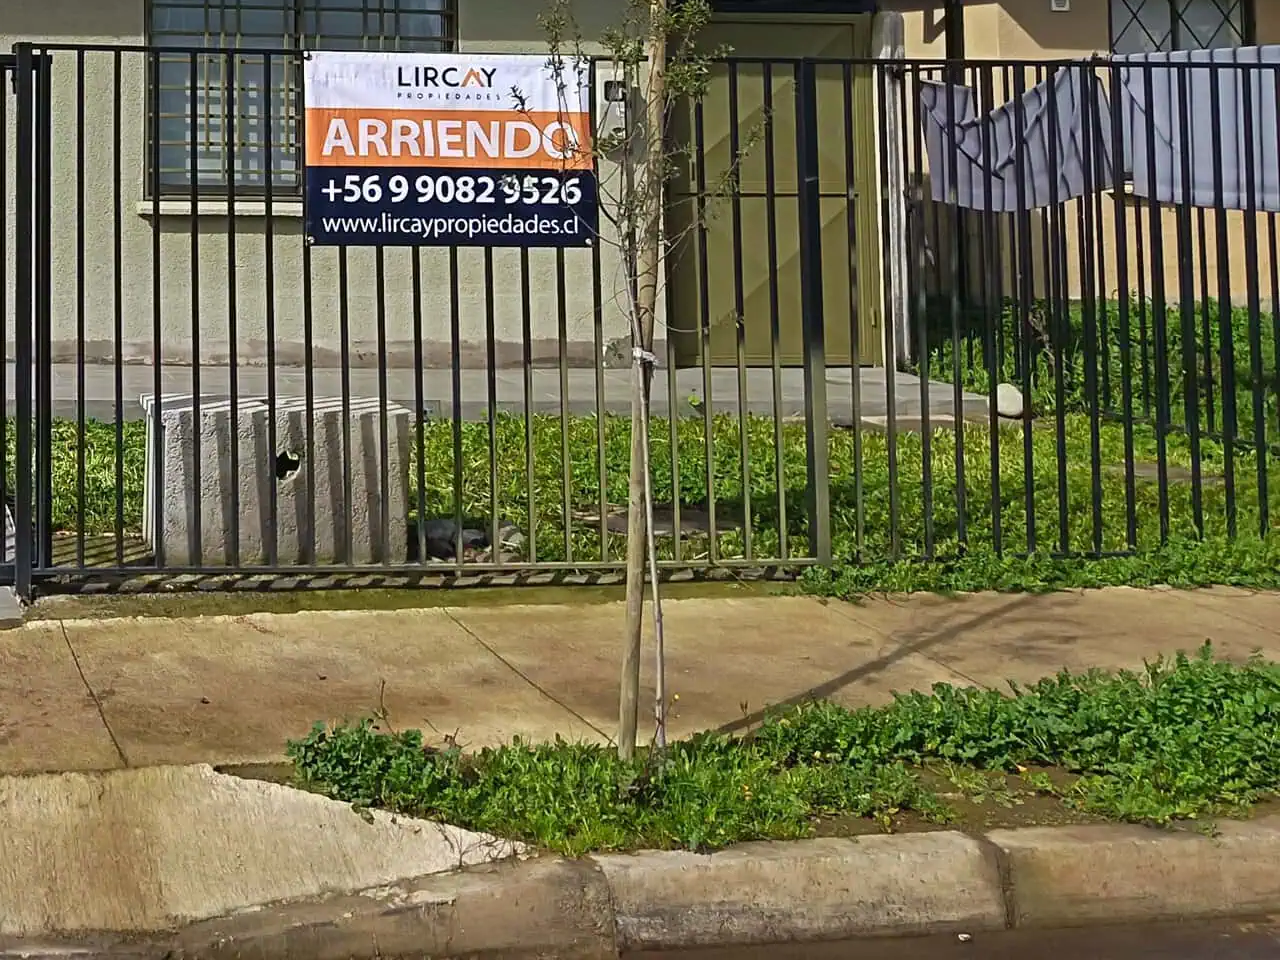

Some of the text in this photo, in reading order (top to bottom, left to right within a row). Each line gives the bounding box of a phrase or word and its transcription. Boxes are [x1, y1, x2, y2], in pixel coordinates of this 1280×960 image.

[398, 66, 497, 88] LIRCAY
[397, 92, 501, 101] PROPIEDADES
[322, 118, 579, 160] ARRIENDO
[322, 174, 582, 204] +56 9 9082 9526
[322, 213, 579, 238] www.lircaypropiedades.cl
